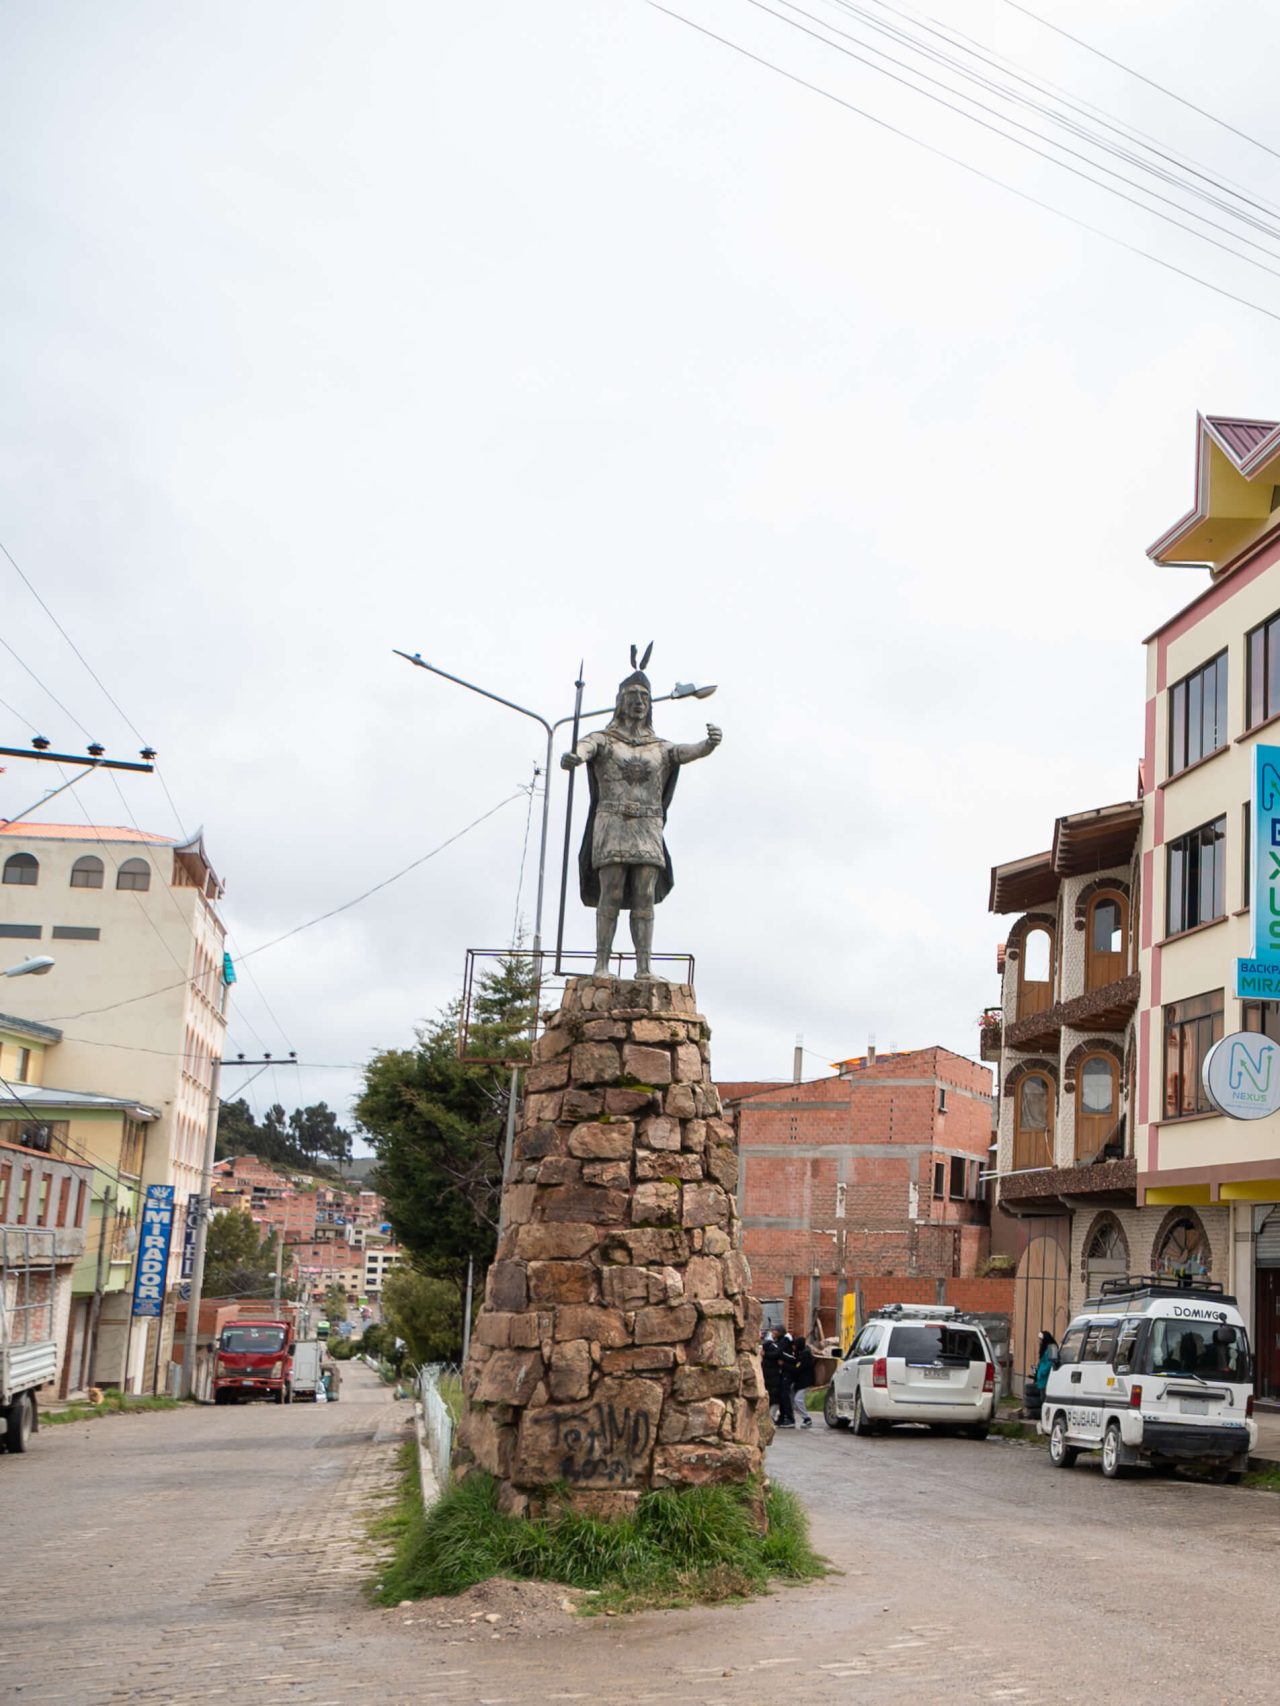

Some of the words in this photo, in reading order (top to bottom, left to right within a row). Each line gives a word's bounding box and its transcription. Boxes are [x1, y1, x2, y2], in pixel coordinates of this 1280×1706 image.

[1232, 1091, 1267, 1102] NEXUS
[146, 1199, 172, 1209] EL
[138, 1210, 171, 1299] MIRADOR
[1173, 1306, 1227, 1321] DOMING
[1072, 1410, 1101, 1428] SUBARU
